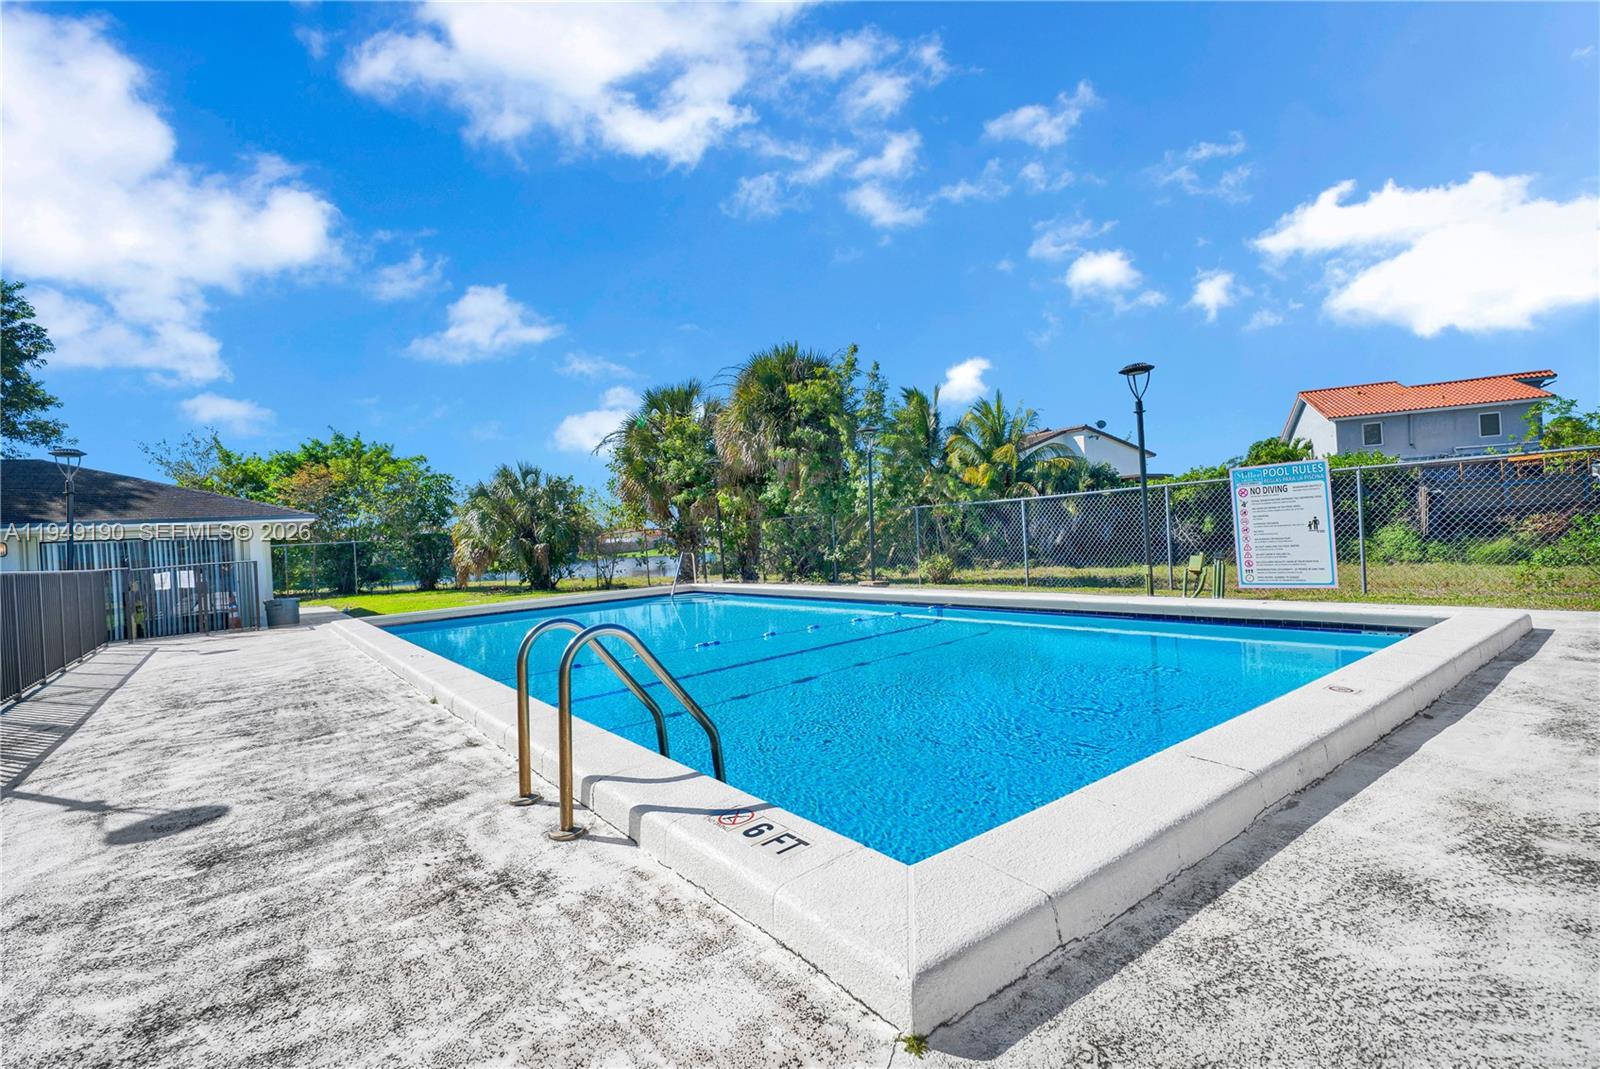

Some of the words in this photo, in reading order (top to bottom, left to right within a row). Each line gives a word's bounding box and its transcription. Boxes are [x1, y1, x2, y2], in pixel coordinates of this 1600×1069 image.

[1263, 467, 1289, 477] POOL
[1292, 464, 1324, 475] RULES
[1250, 487, 1261, 495] NO
[1262, 485, 1288, 494] DIVING
[742, 823, 774, 838] 6
[761, 832, 811, 855] FT
